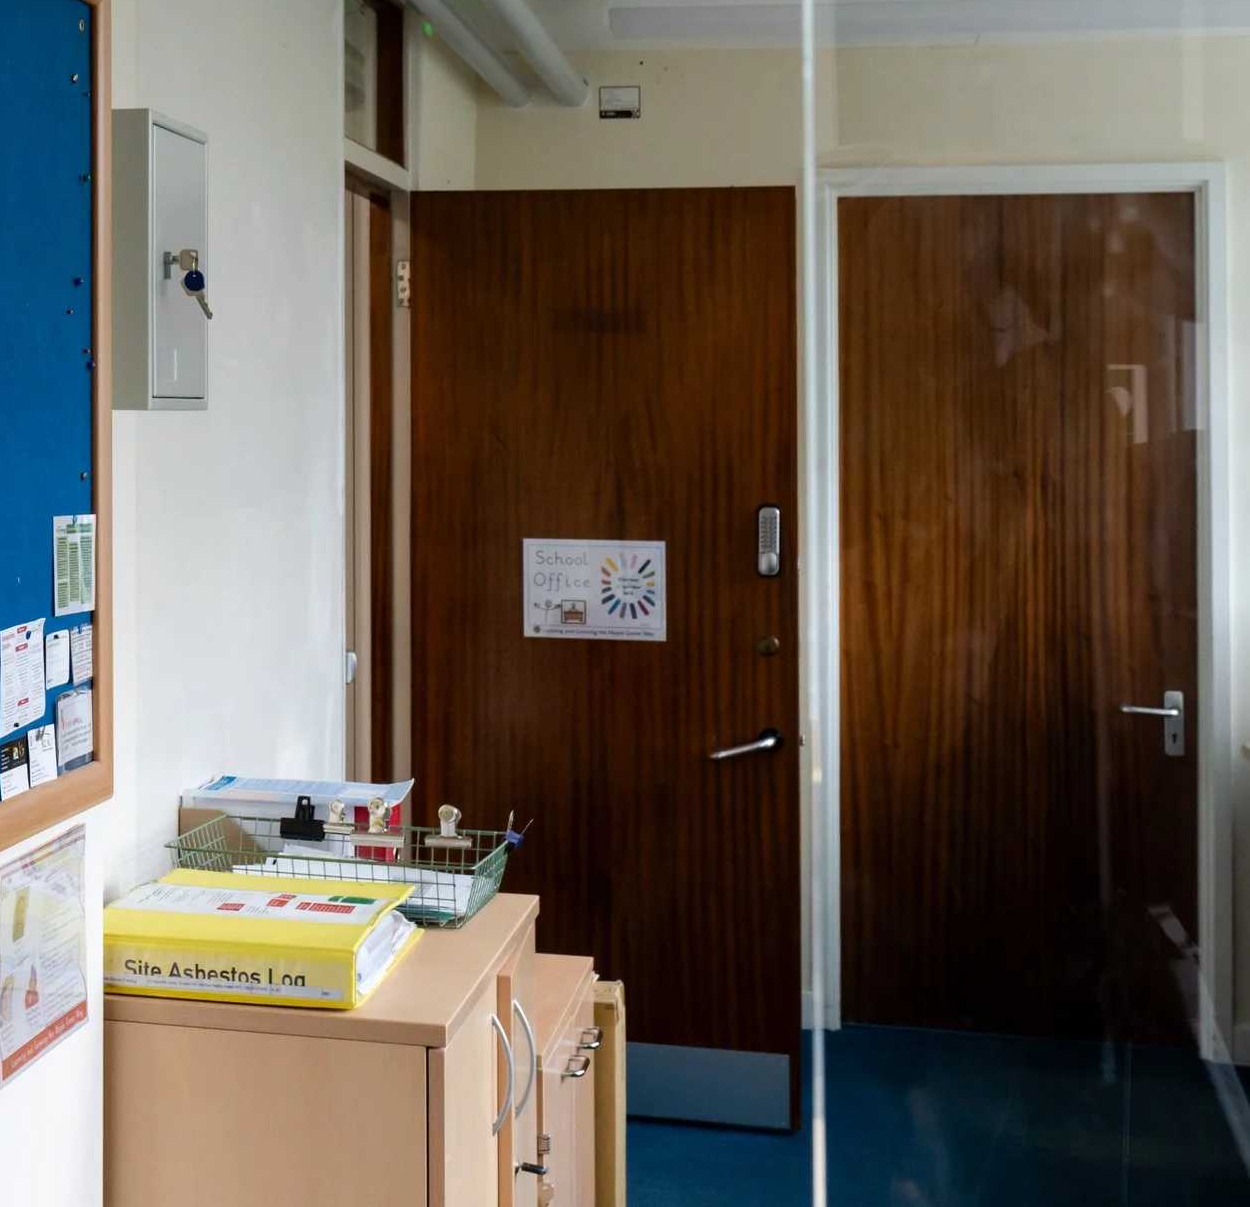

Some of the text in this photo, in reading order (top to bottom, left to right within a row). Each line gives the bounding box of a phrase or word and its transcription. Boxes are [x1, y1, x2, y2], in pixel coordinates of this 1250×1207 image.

[534, 549, 589, 566] School
[533, 572, 591, 592] Office
[124, 959, 162, 977] Site
[168, 962, 261, 984] Asbestos
